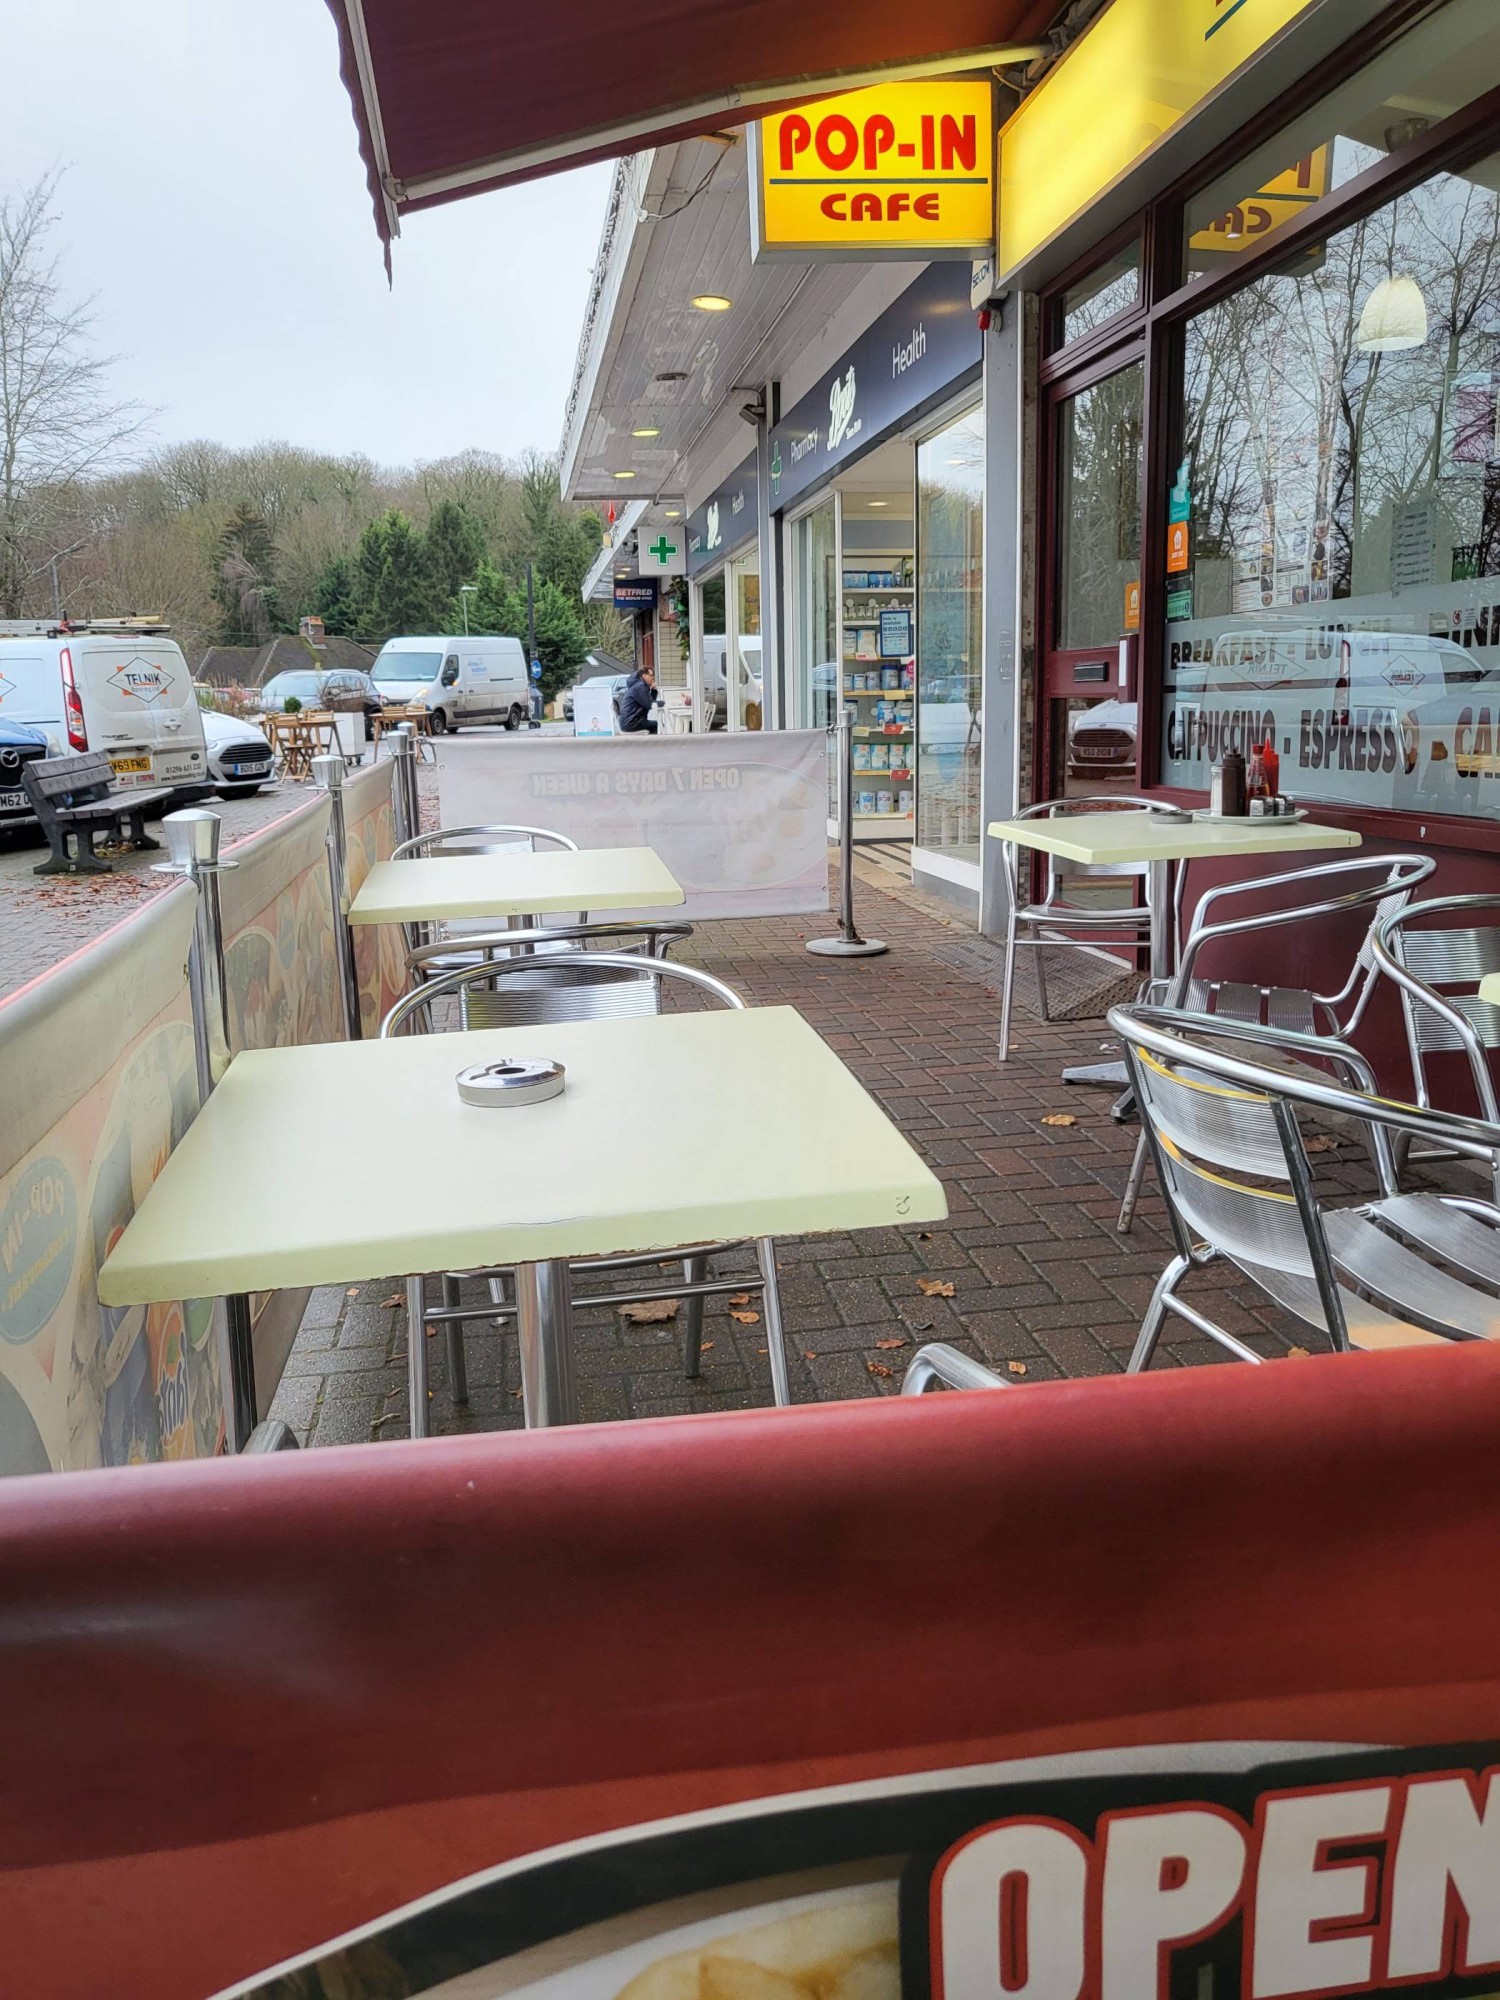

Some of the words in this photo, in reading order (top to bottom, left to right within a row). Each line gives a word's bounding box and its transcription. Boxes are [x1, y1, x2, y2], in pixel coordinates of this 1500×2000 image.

[779, 114, 976, 171] POP-IN
[820, 192, 940, 221] CAFE
[892, 322, 926, 379] Health
[790, 427, 818, 467] Pharmacy
[616, 588, 653, 596] BETFRED
[1171, 636, 1279, 670] BREAKFAST
[124, 672, 162, 686] TELNIK
[1168, 709, 1276, 764] CAPPUCCINO
[1299, 708, 1420, 775] ESPRESSO
[1455, 706, 1500, 778] CA
[130, 758, 148, 769] FNG
[932, 1769, 1500, 2000] OPEN
